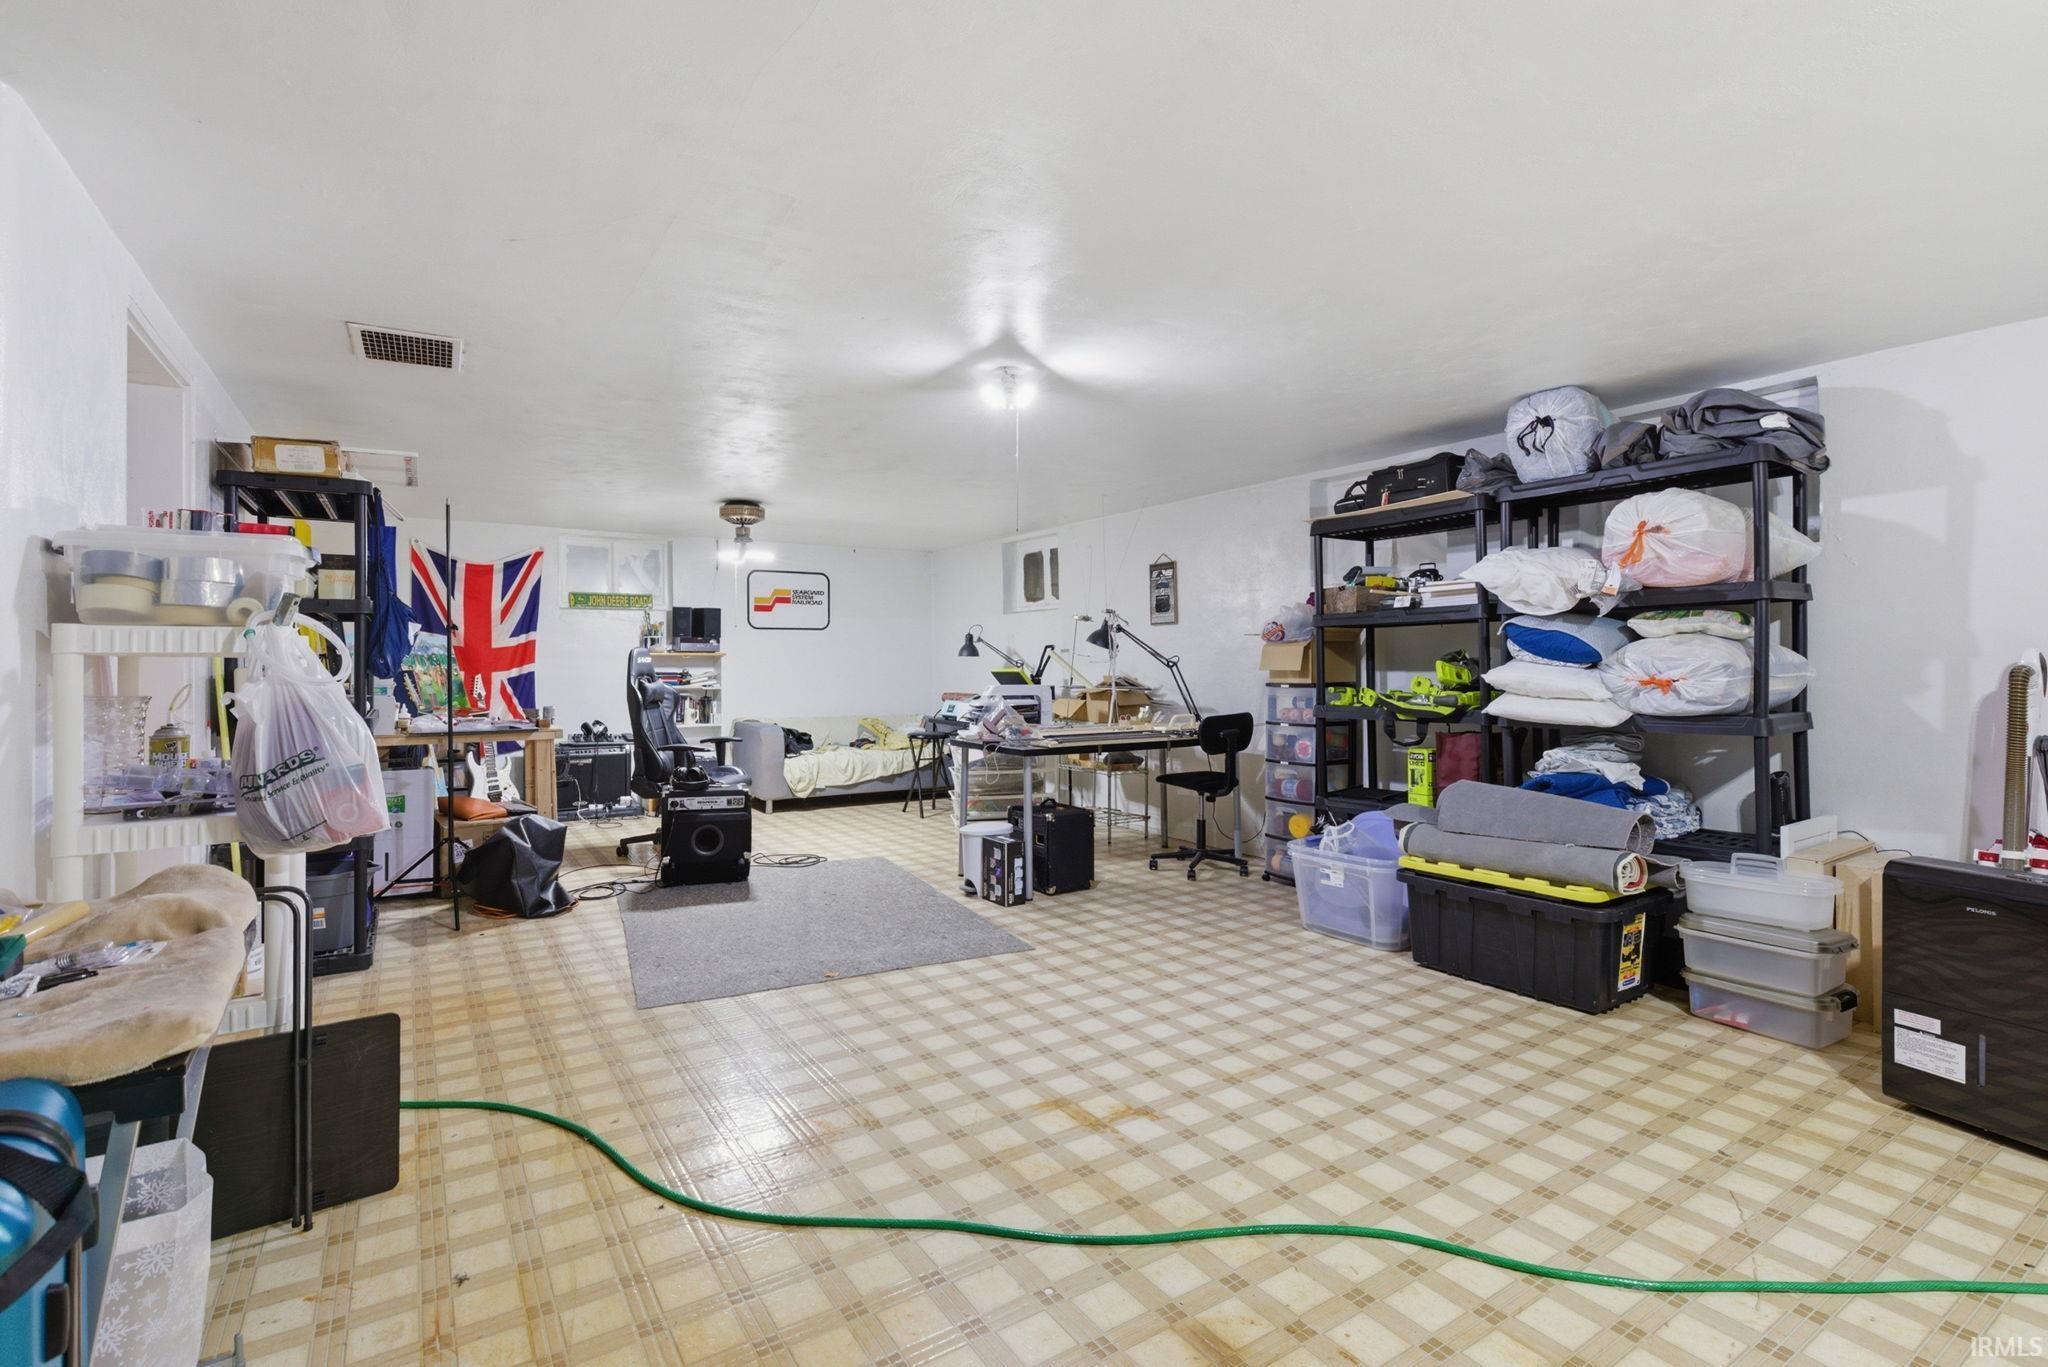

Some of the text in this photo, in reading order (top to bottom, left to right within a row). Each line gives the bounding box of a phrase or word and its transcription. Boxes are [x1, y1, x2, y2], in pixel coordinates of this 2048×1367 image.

[588, 595, 606, 606] JOHN
[607, 595, 629, 606] DEERE
[240, 749, 316, 790] ARDS
[267, 782, 291, 798] Service
[300, 766, 326, 783] Quality
